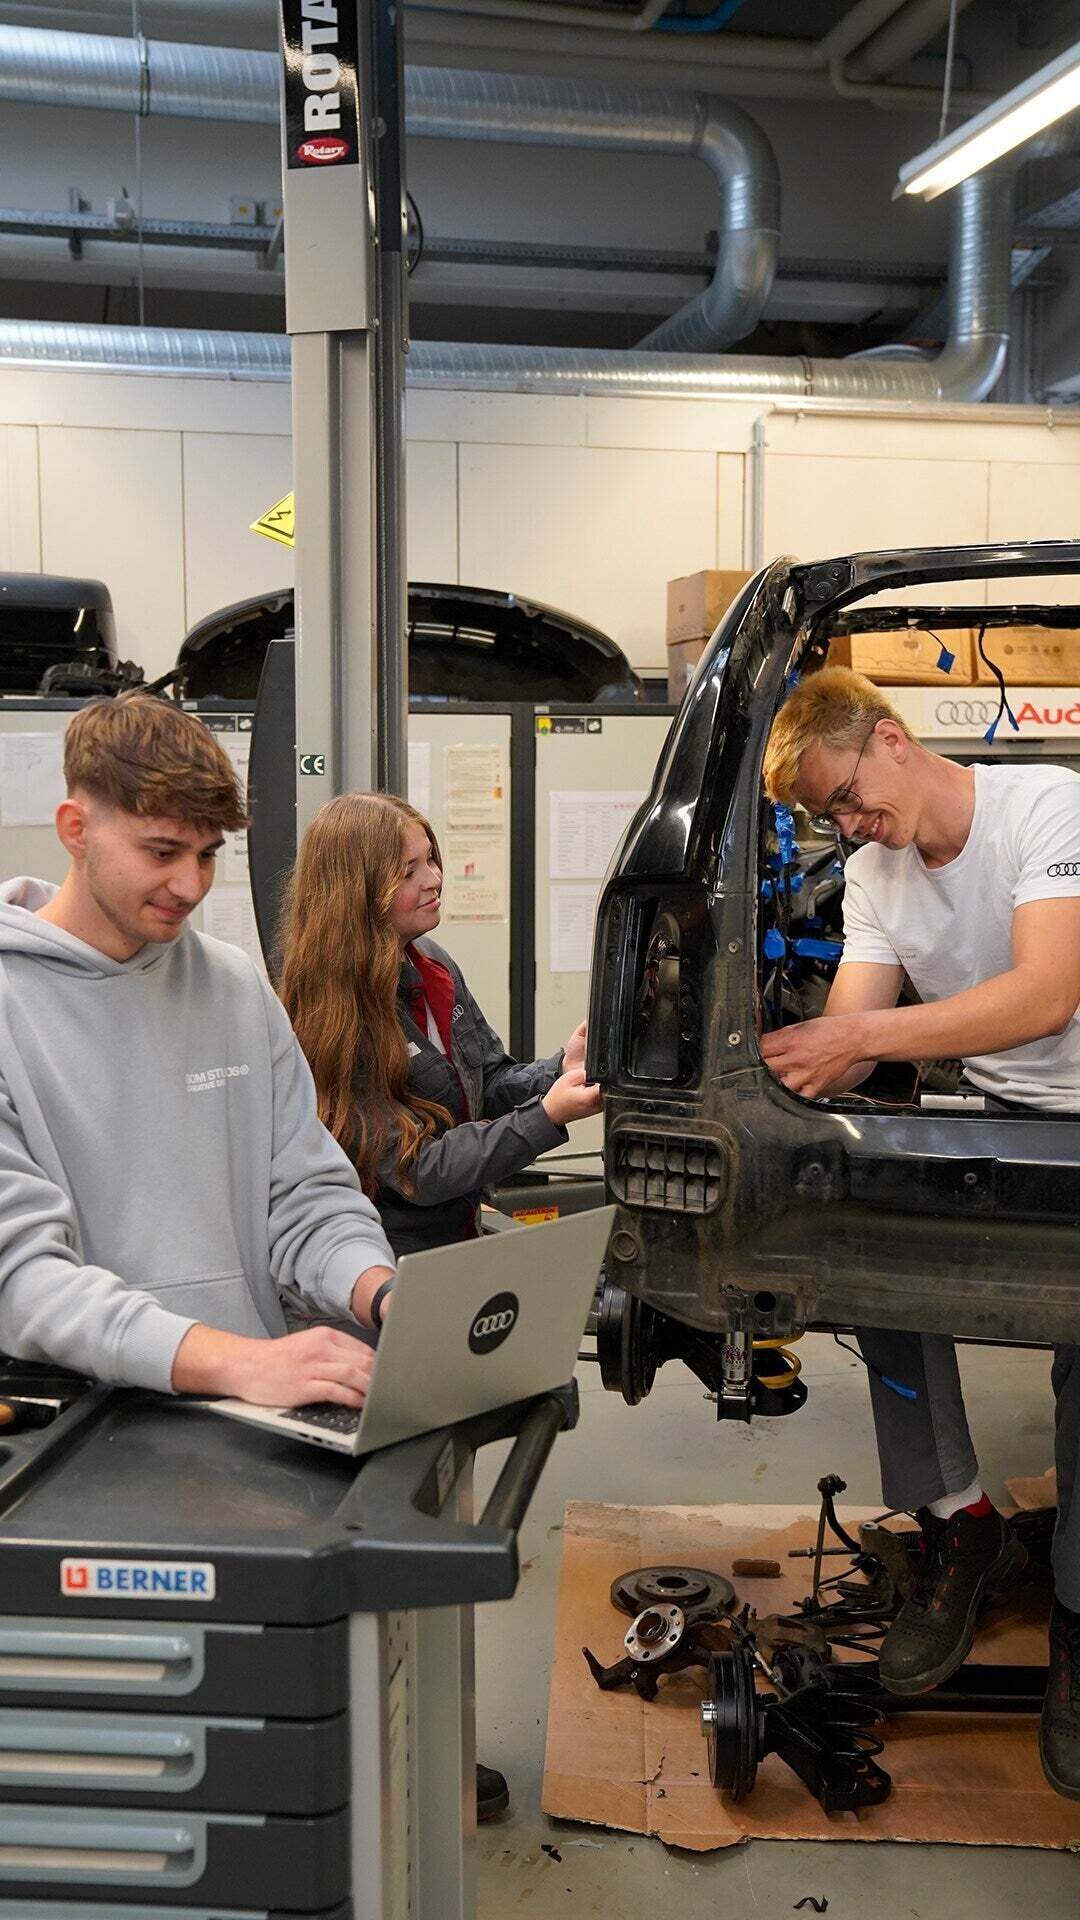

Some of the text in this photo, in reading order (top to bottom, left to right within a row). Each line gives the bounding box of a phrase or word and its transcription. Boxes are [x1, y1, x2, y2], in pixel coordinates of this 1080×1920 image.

[302, 0, 340, 132] ROTA
[302, 144, 345, 160] Rotary
[301, 755, 324, 774] CE
[97, 1568, 208, 1593] BERNER
